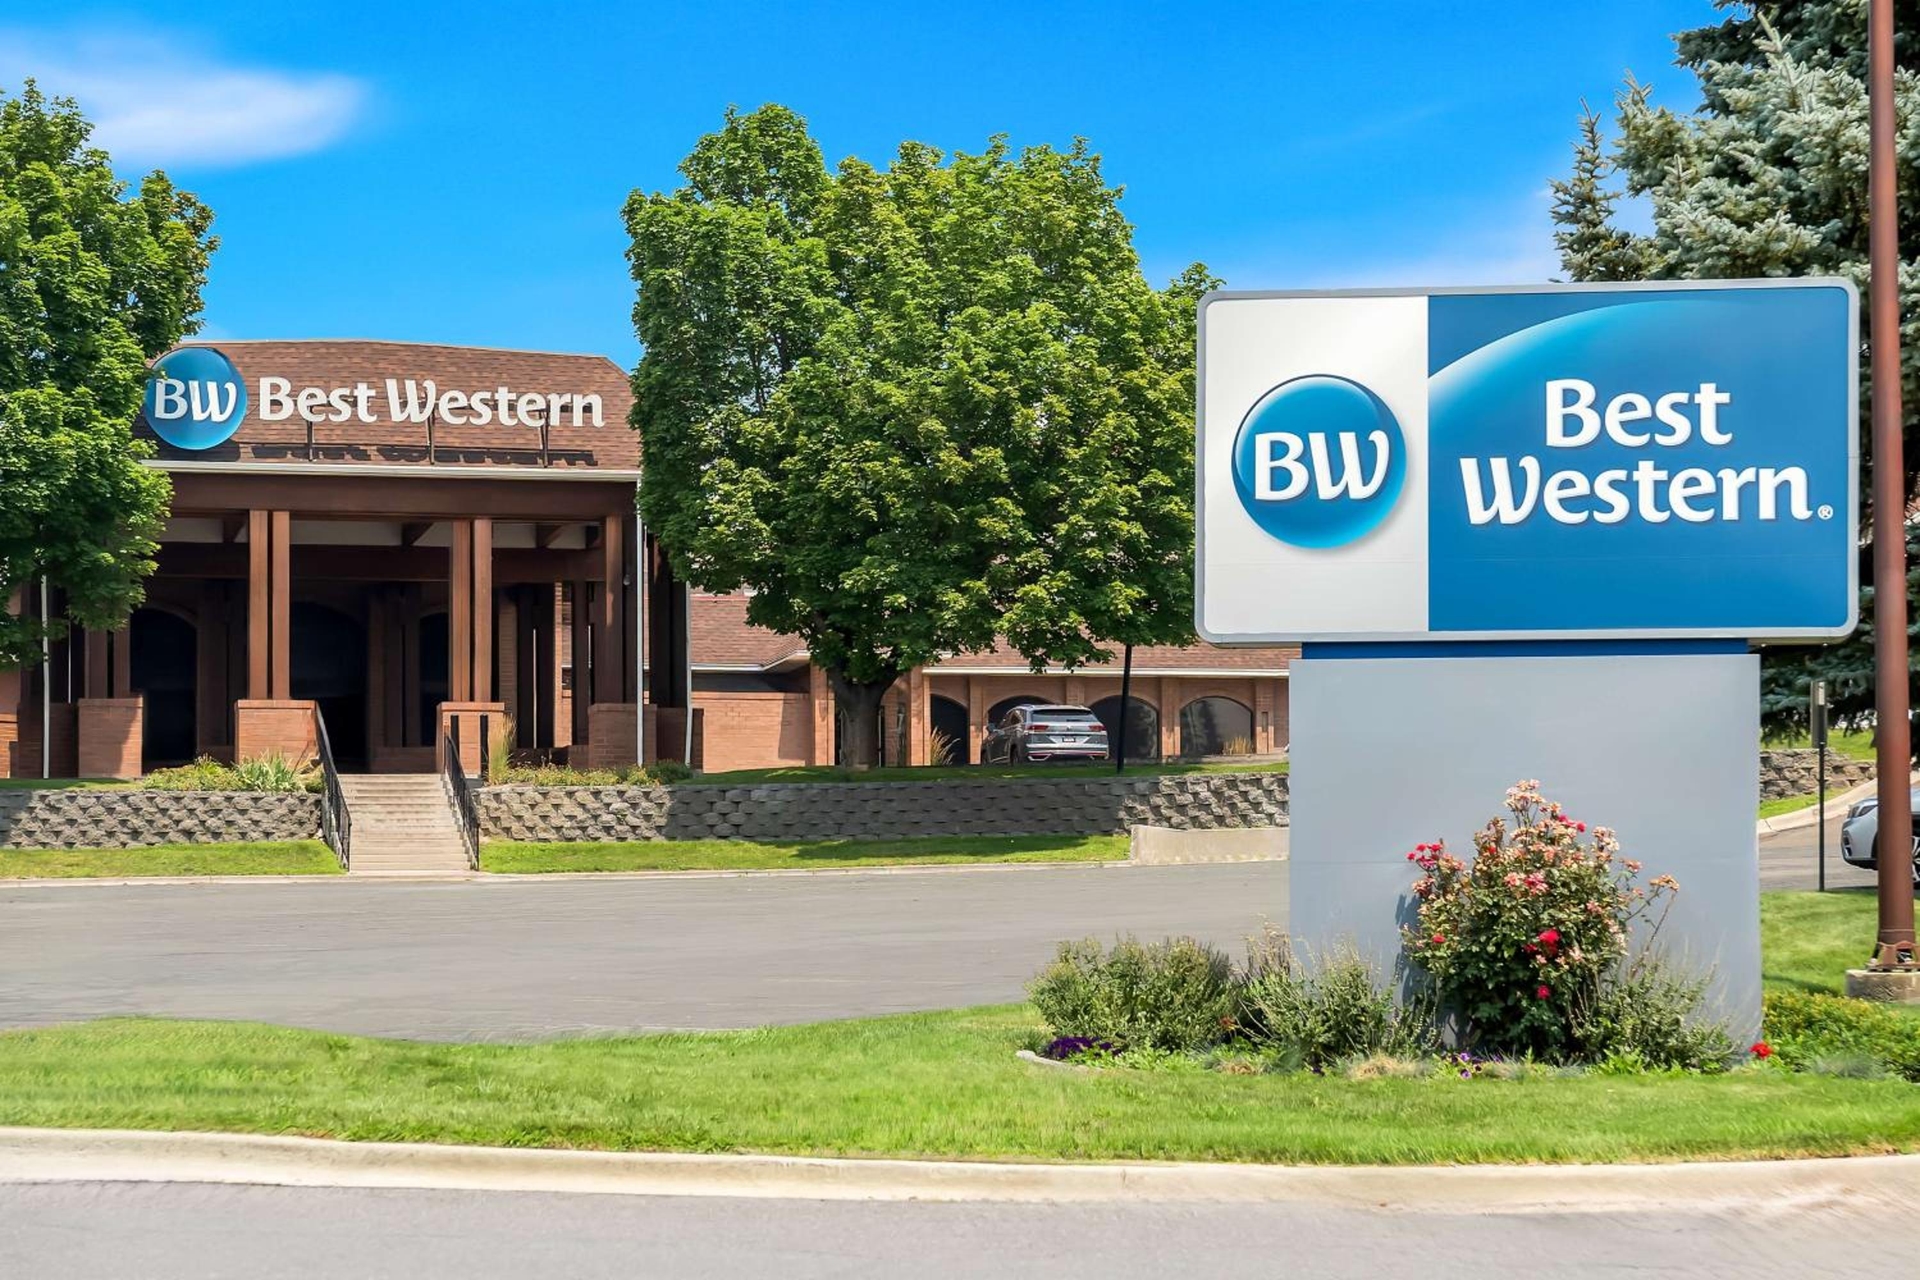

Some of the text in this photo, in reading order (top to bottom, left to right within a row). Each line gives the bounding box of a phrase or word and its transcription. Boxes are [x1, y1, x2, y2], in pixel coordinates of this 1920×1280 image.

[154, 378, 237, 422] BW
[258, 377, 605, 427] Best Western
[1544, 378, 1733, 448] Best
[1253, 430, 1390, 500] BW
[1459, 455, 1813, 525] Western
